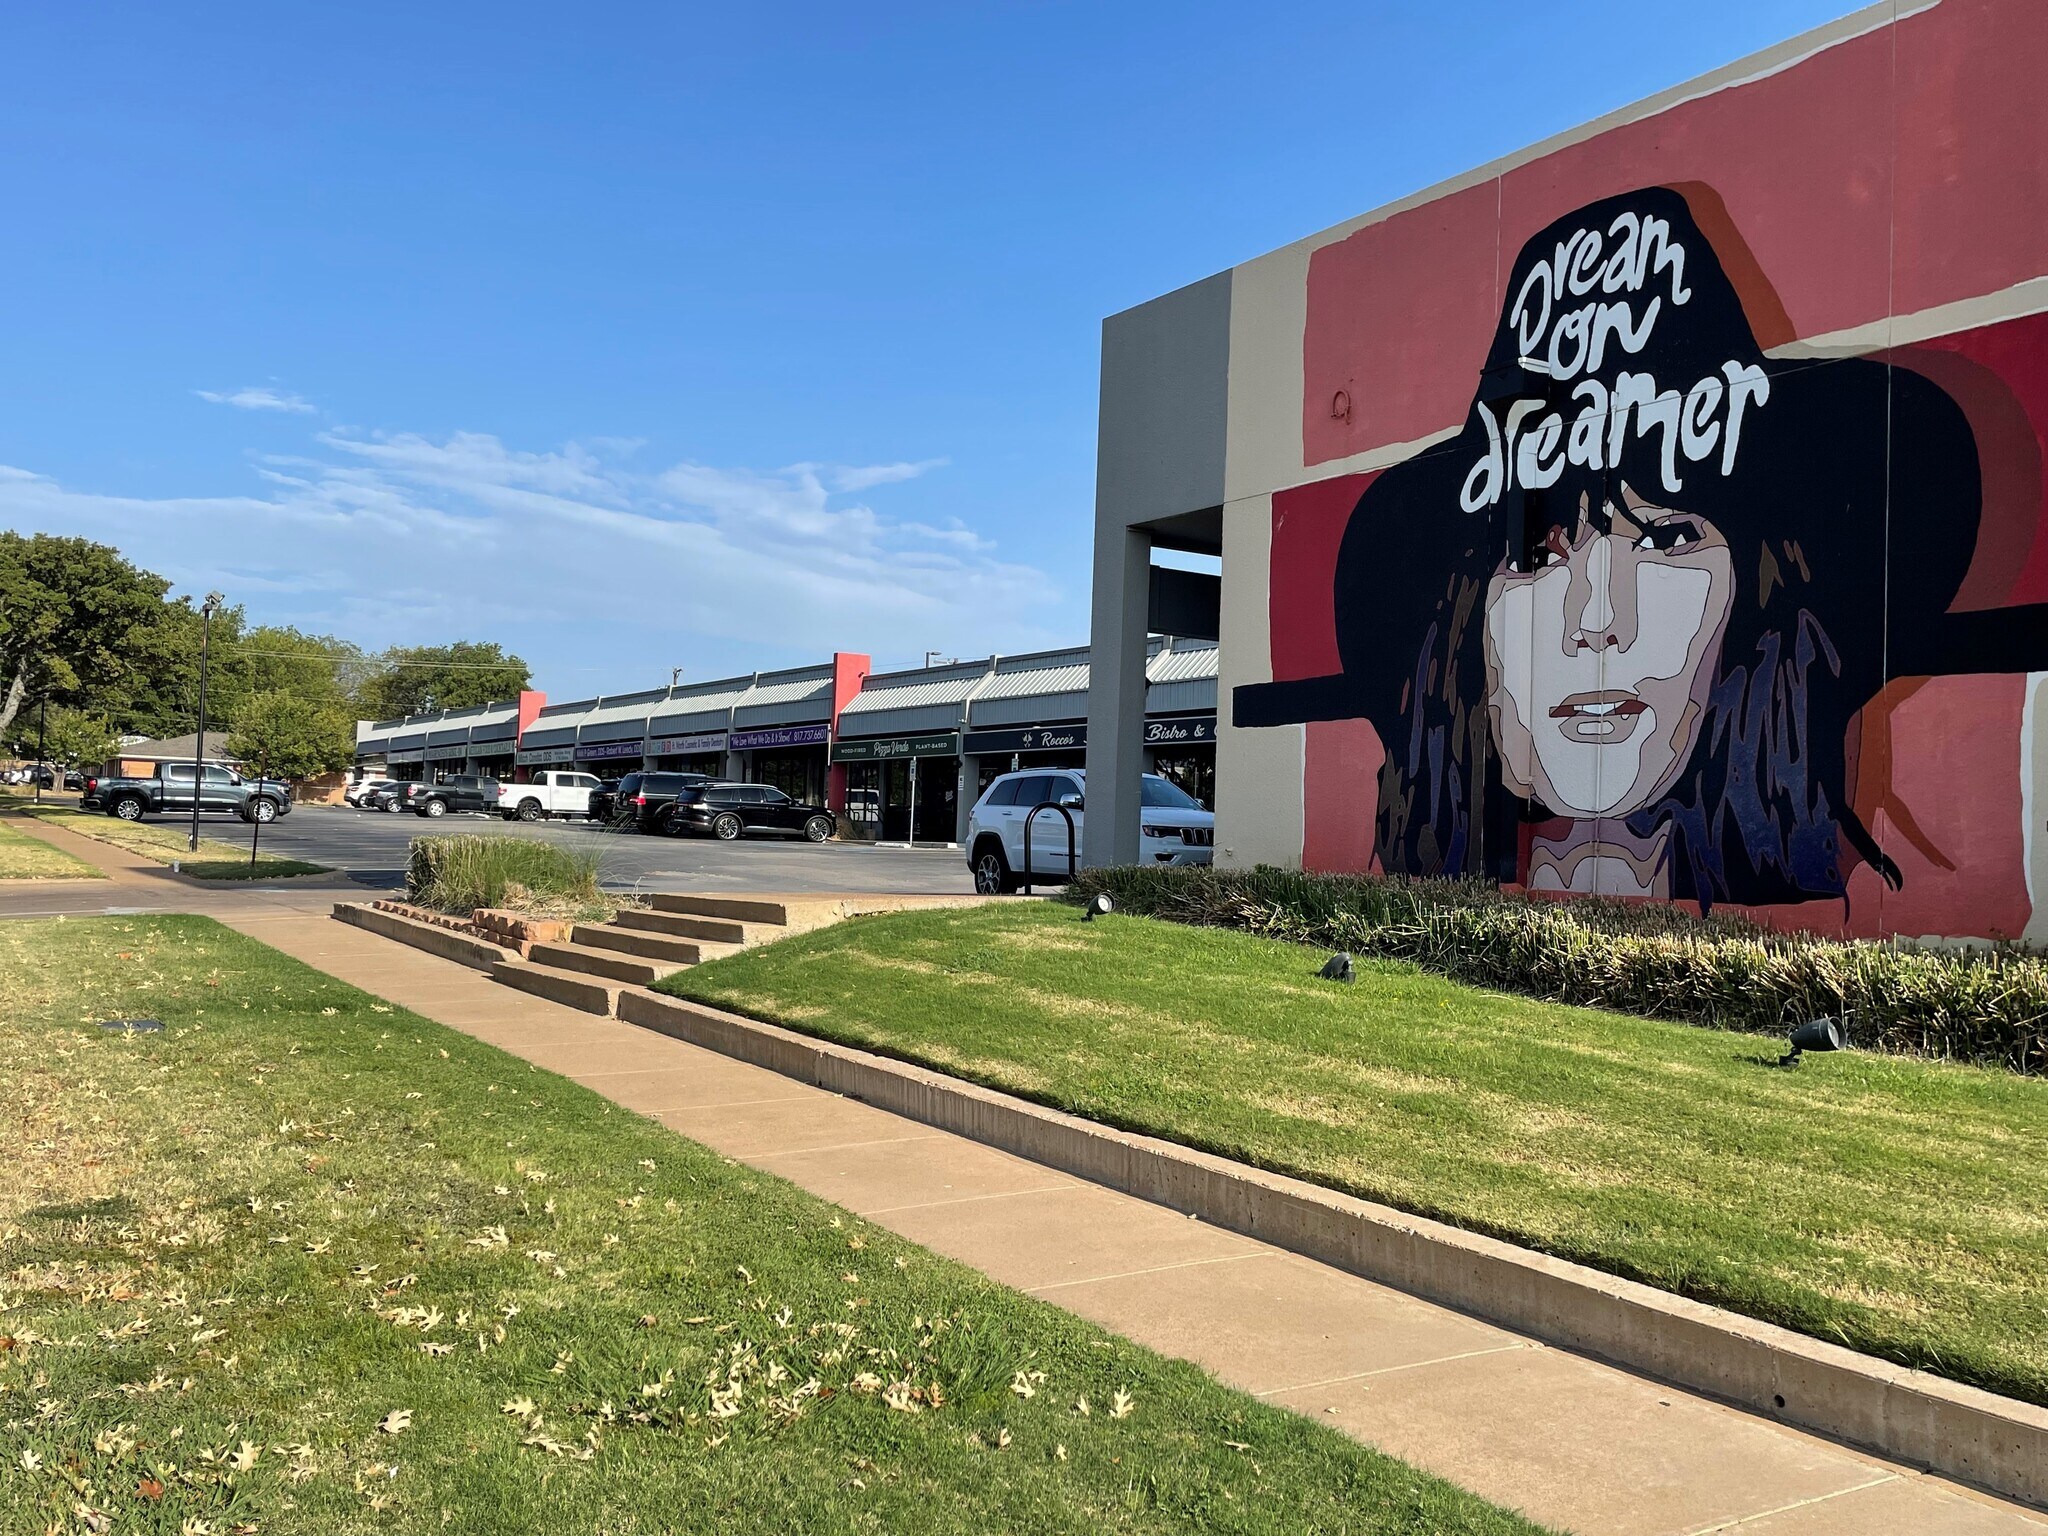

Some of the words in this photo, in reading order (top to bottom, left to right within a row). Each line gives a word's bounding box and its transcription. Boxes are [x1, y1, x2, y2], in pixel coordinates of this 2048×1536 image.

[1510, 211, 1691, 356] Dream
[1549, 296, 1661, 380] on
[1460, 360, 1770, 513] dreamer
[1041, 732, 1075, 747] Rocco's
[1145, 723, 1188, 741] Bistro
[1193, 724, 1205, 737] &
[873, 741, 891, 757] Pizza
[891, 740, 909, 755] Verde
[915, 742, 948, 750] PLANT-BASED
